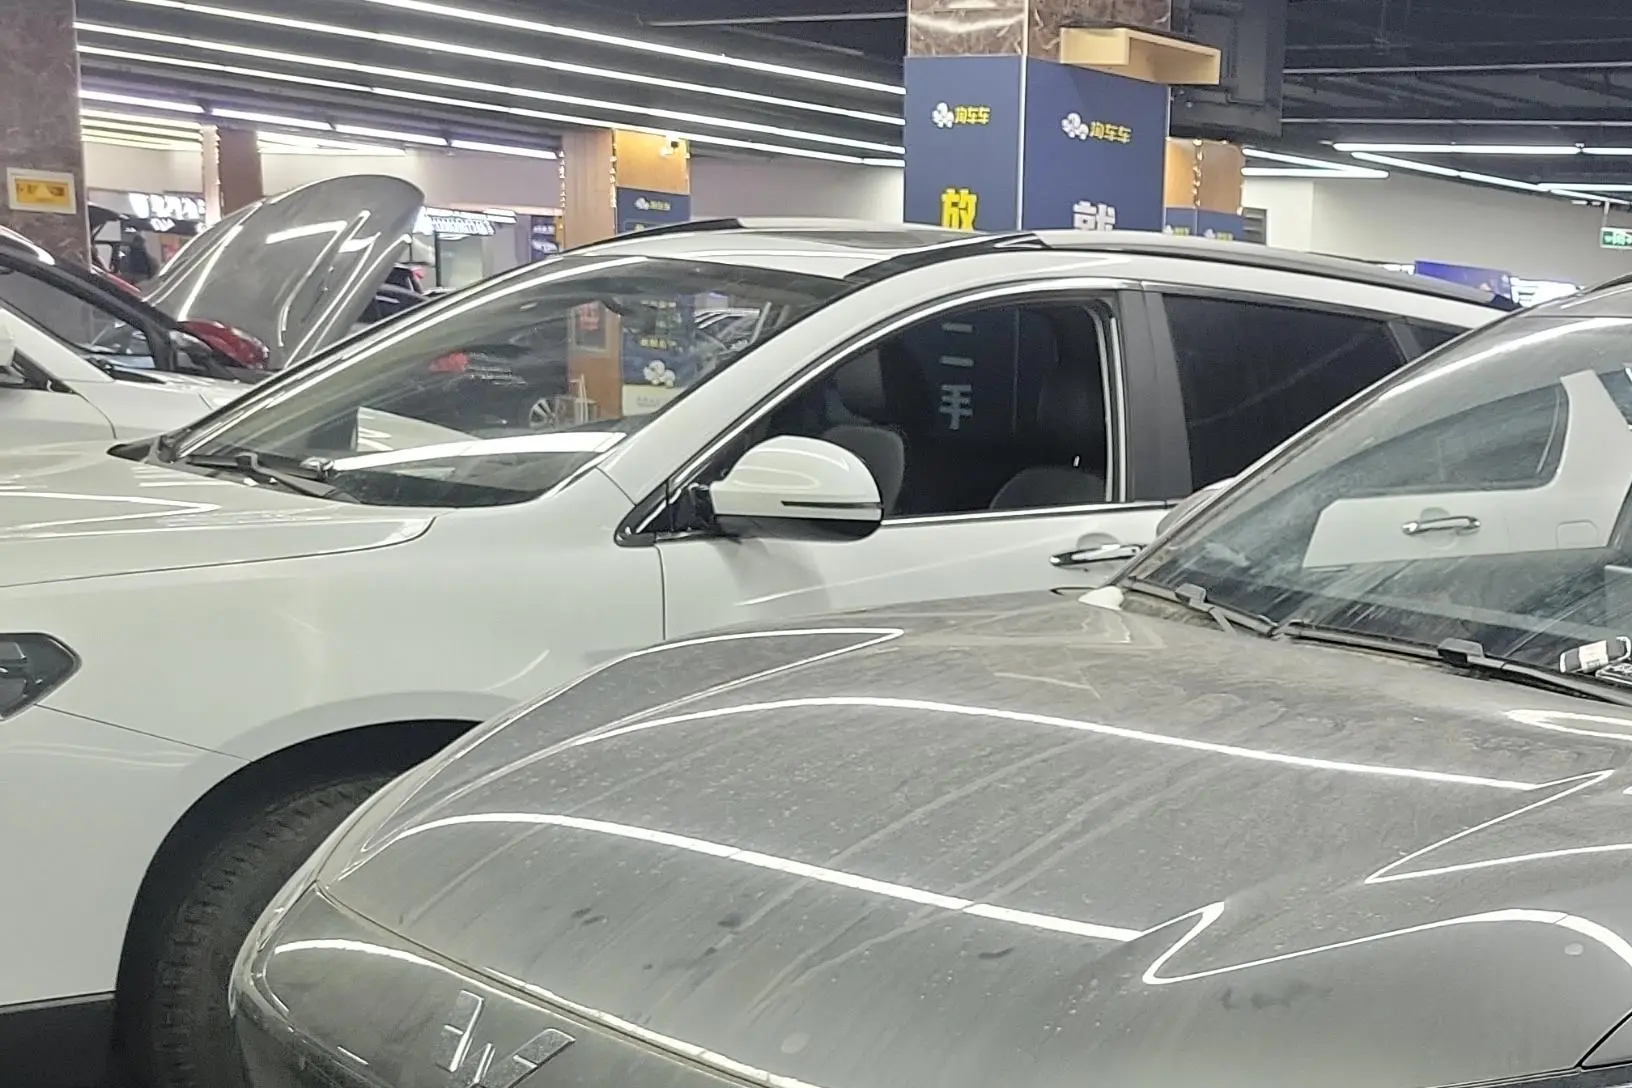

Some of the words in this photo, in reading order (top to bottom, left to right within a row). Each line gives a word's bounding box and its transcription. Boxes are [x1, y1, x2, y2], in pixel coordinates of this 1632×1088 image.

[1089, 121, 1132, 144] 淘车车
[941, 188, 977, 231] 放
